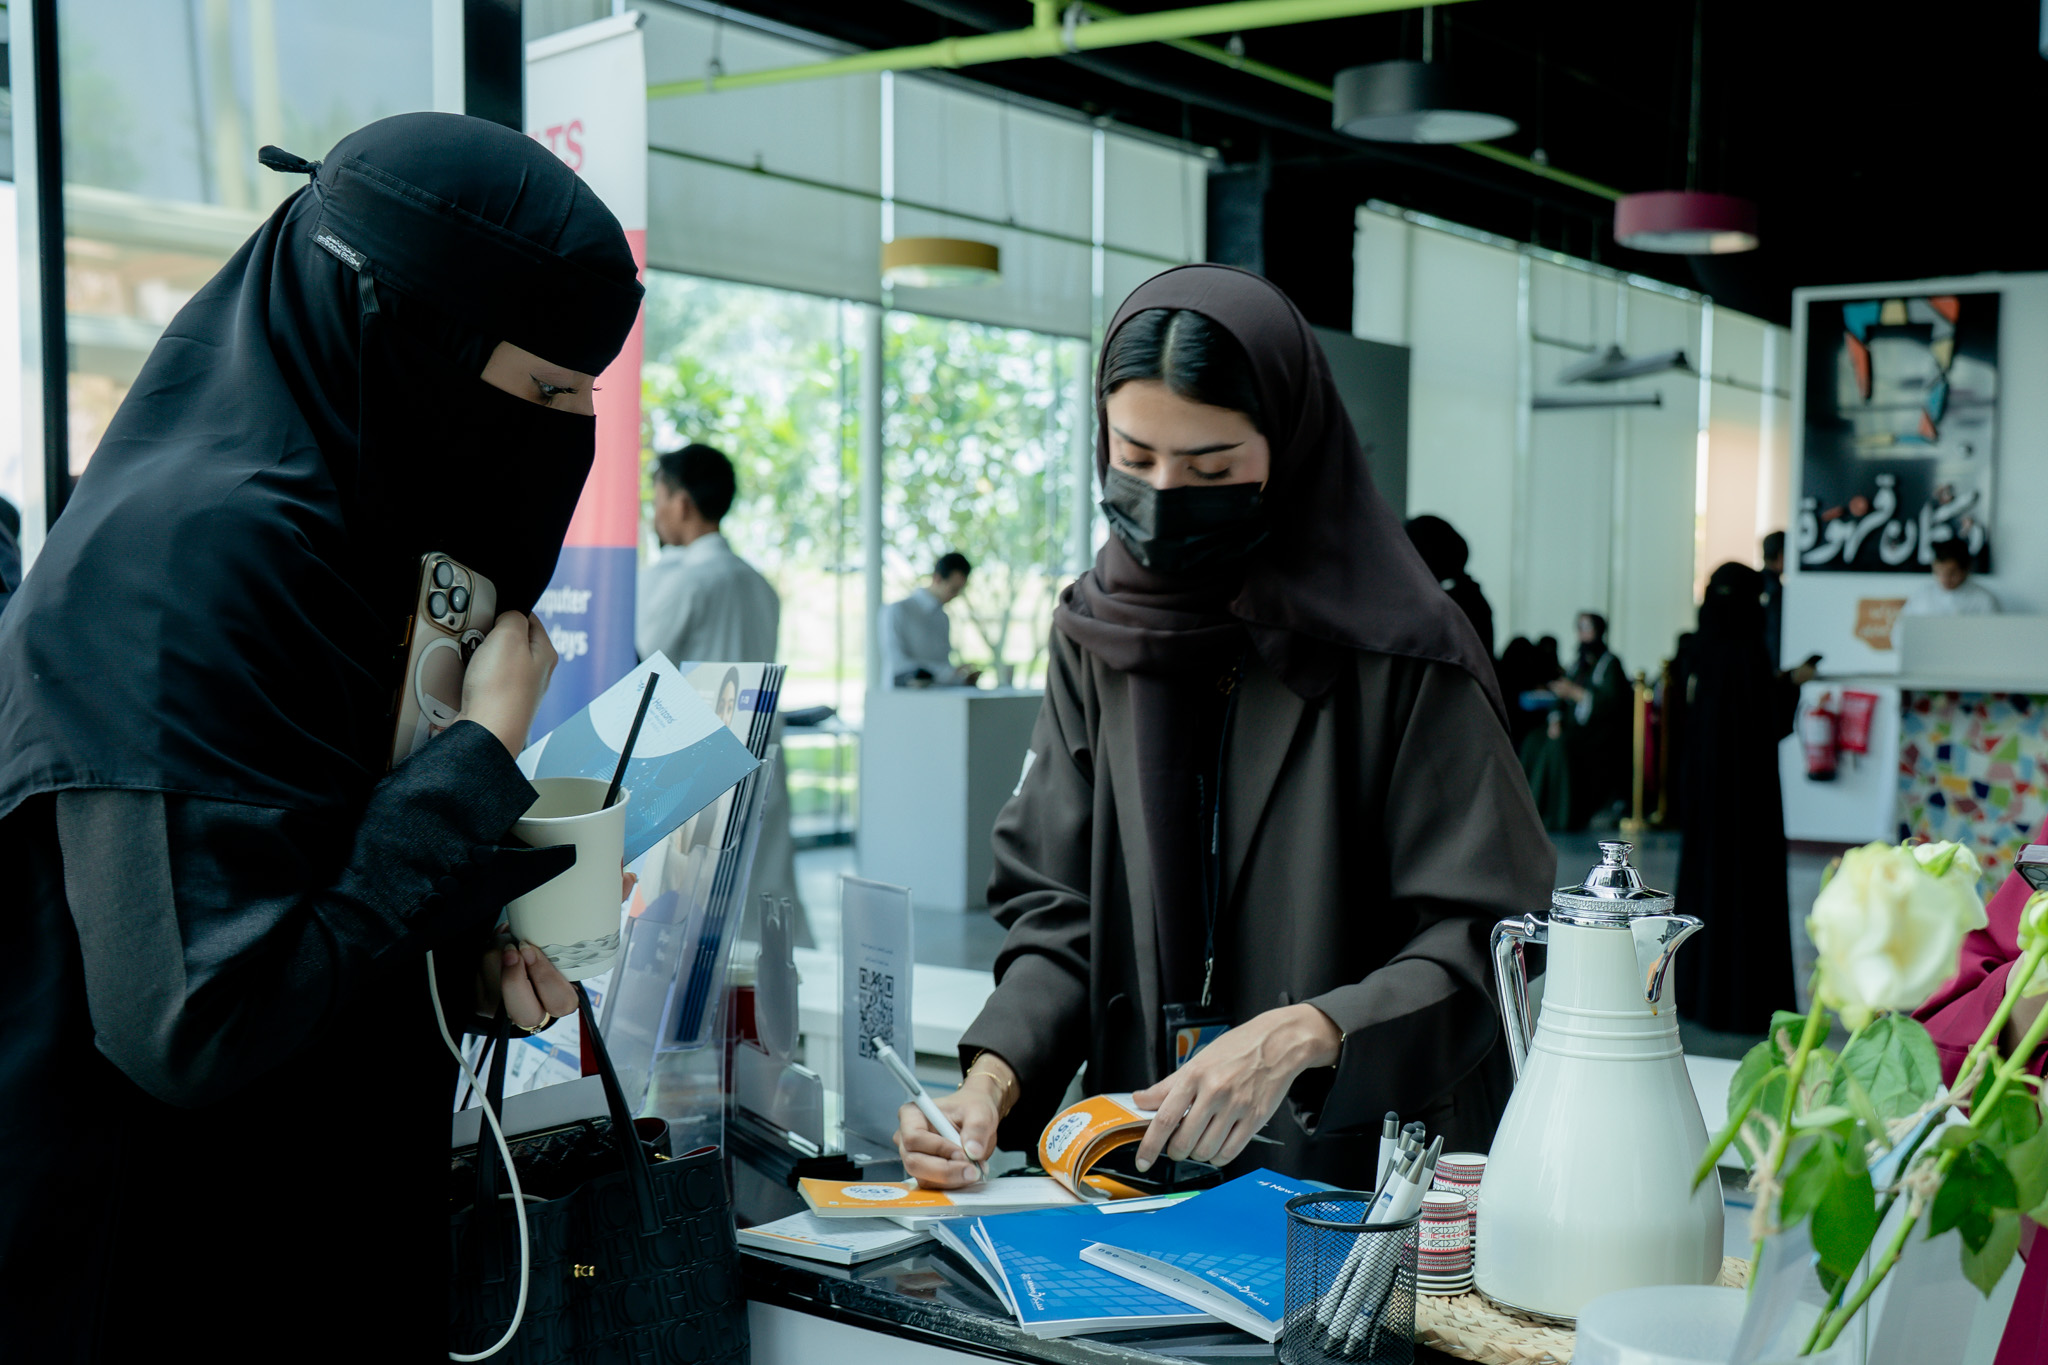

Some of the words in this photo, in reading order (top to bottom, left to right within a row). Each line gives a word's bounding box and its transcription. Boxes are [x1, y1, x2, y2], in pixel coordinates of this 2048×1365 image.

[527, 119, 584, 172] TS
[1798, 473, 1898, 565] قهوة
[551, 623, 589, 662] days
[652, 697, 674, 725] Horizons
[1047, 1115, 1080, 1150] 35%
[849, 1186, 896, 1195] 35%
[1269, 1183, 1295, 1195] New
